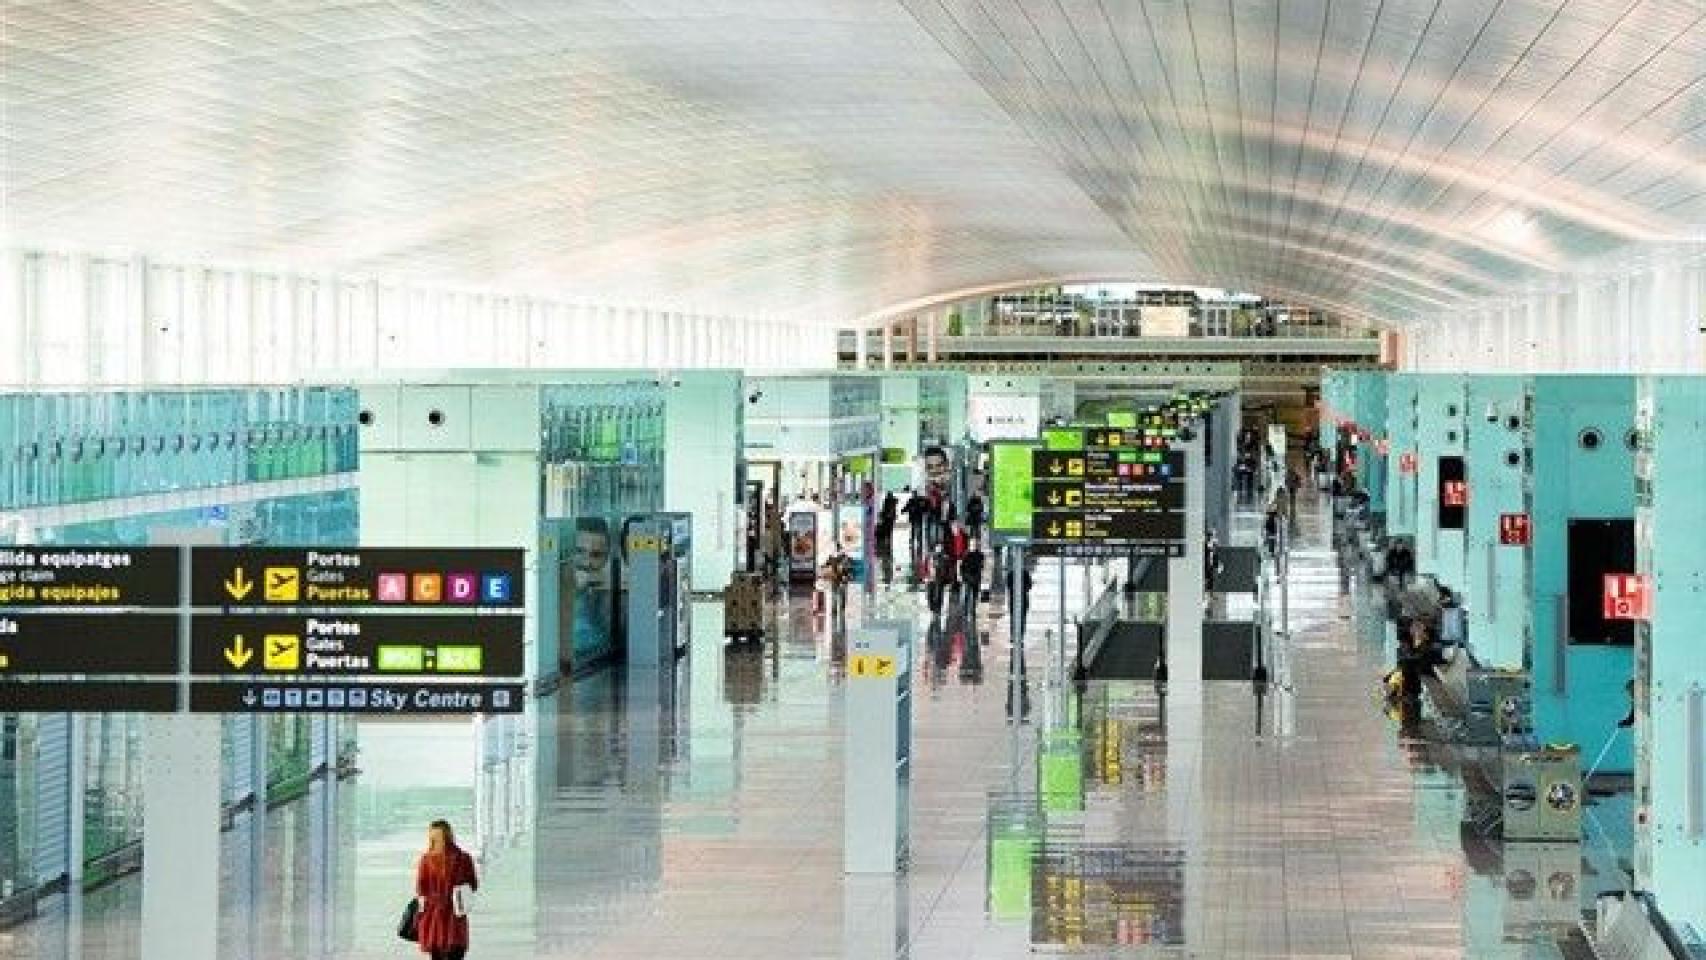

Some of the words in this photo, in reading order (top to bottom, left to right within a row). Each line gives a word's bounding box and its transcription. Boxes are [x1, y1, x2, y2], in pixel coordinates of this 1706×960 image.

[40, 549, 131, 569] equipatges
[306, 551, 361, 566] Portes
[306, 570, 345, 582] Gates
[40, 584, 120, 603] equipajes
[306, 583, 370, 600] Puertas
[386, 577, 401, 597] A
[419, 577, 435, 596] C
[453, 577, 470, 598] D
[489, 577, 502, 598] E
[306, 618, 361, 635] Portes
[306, 637, 345, 651] Gates
[306, 652, 369, 668] Puertas
[370, 687, 409, 710] Sky
[414, 688, 483, 707] Centre
